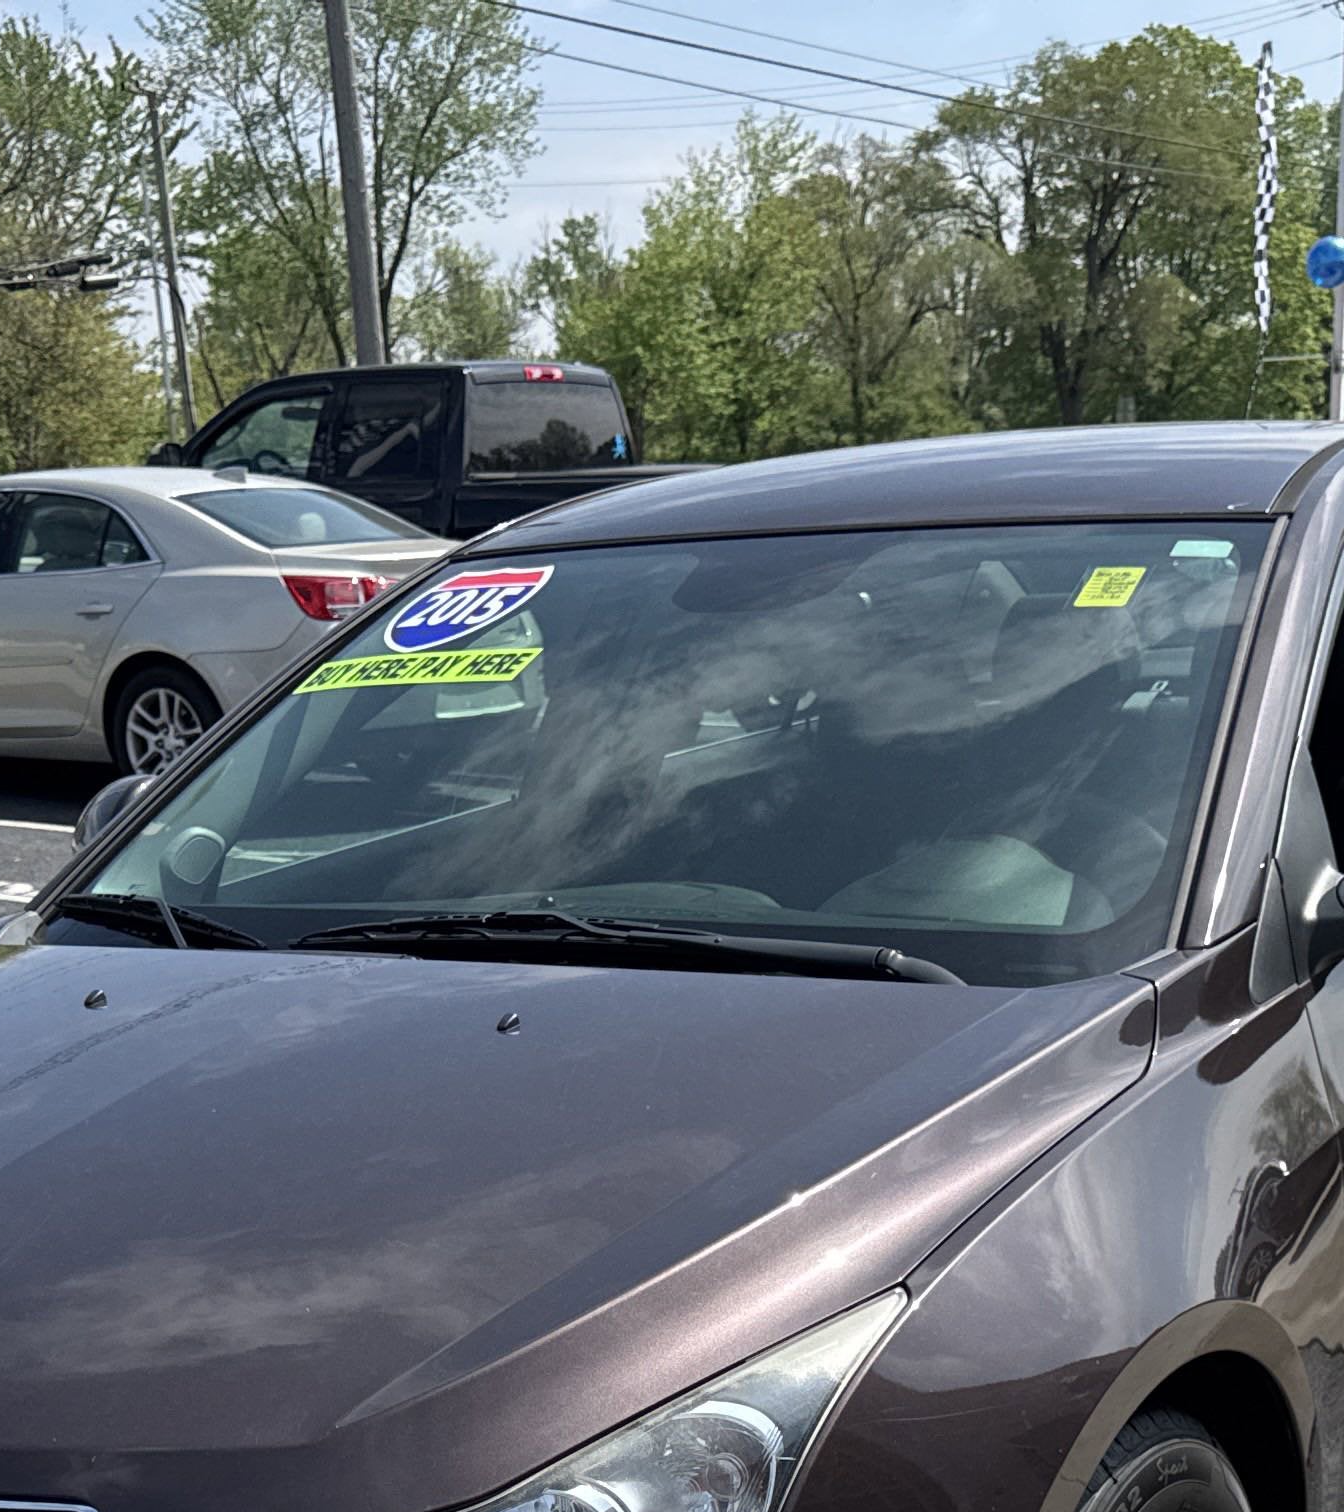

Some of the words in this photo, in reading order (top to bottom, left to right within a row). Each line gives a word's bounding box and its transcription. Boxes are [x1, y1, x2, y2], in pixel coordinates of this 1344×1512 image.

[396, 587, 526, 628] 2015
[305, 662, 358, 688] BUY
[456, 652, 534, 677] HERE
